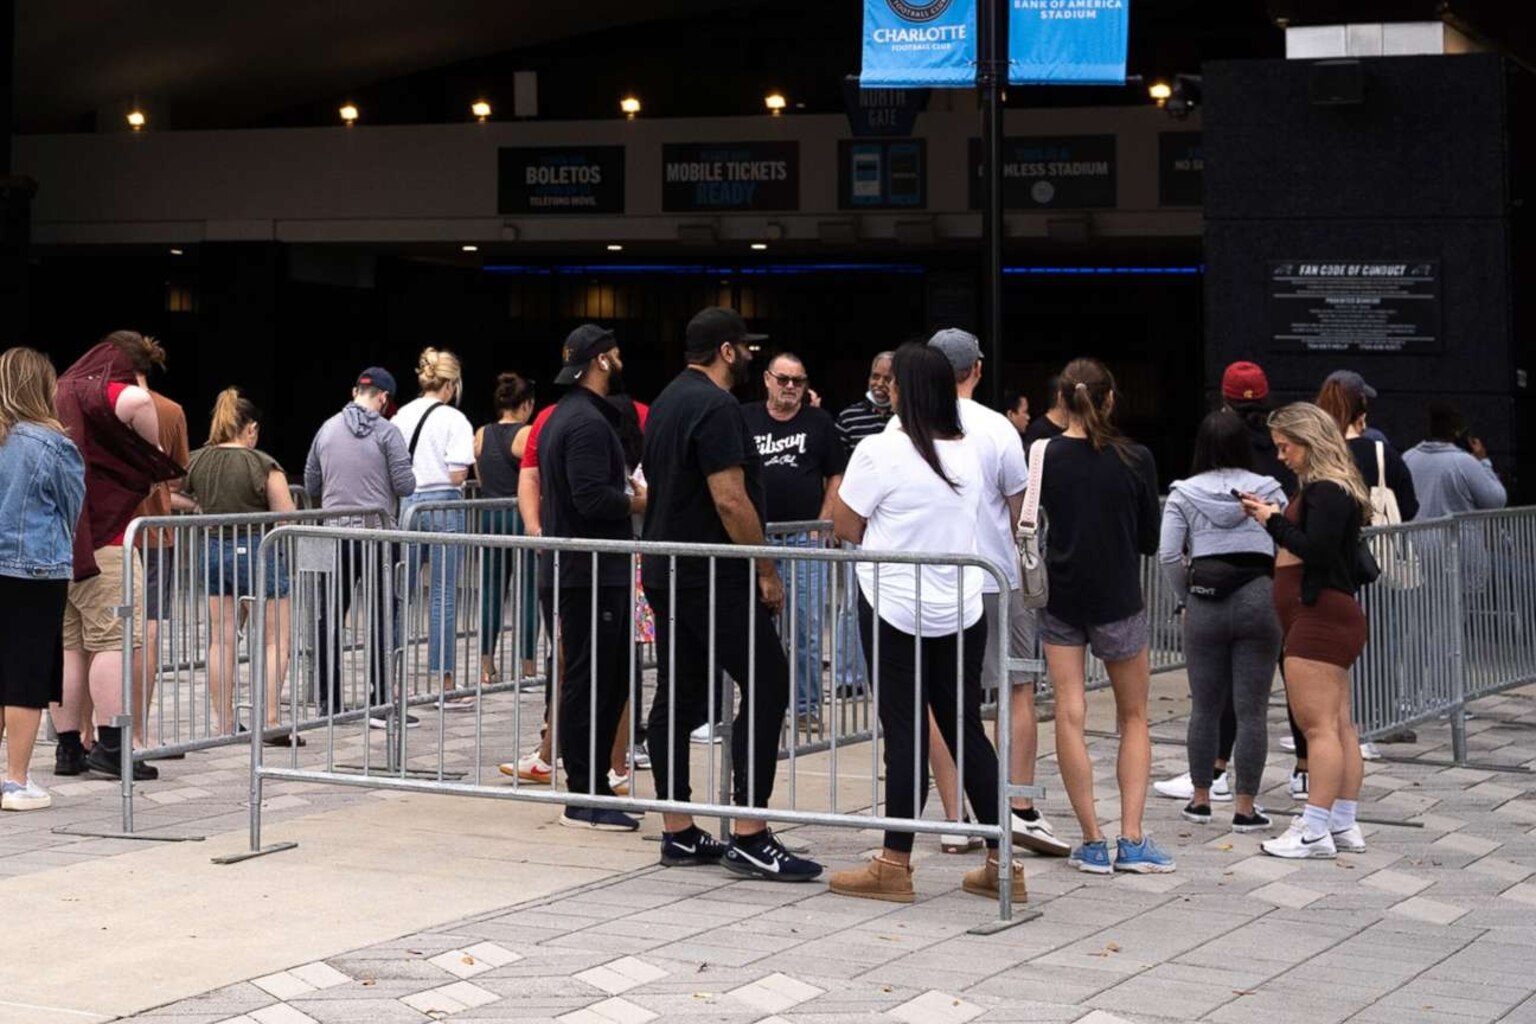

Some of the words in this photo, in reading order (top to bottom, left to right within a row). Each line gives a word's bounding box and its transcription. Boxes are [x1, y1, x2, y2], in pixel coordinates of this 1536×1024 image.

[1014, 0, 1047, 8] BANK
[1049, 0, 1066, 8] OF
[1067, 0, 1122, 8] AMERICA
[1040, 10, 1097, 19] STADIUM
[873, 24, 966, 43] CHARLOTTE
[525, 165, 602, 185] BOLETOS
[666, 162, 723, 182] MOBILE
[726, 160, 788, 181] TICKETS
[1049, 161, 1109, 176] STADIUM
[1299, 264, 1319, 276] FAN
[1320, 264, 1346, 276] CODE
[1348, 264, 1361, 276] OF
[1362, 264, 1407, 276] CONDUCT
